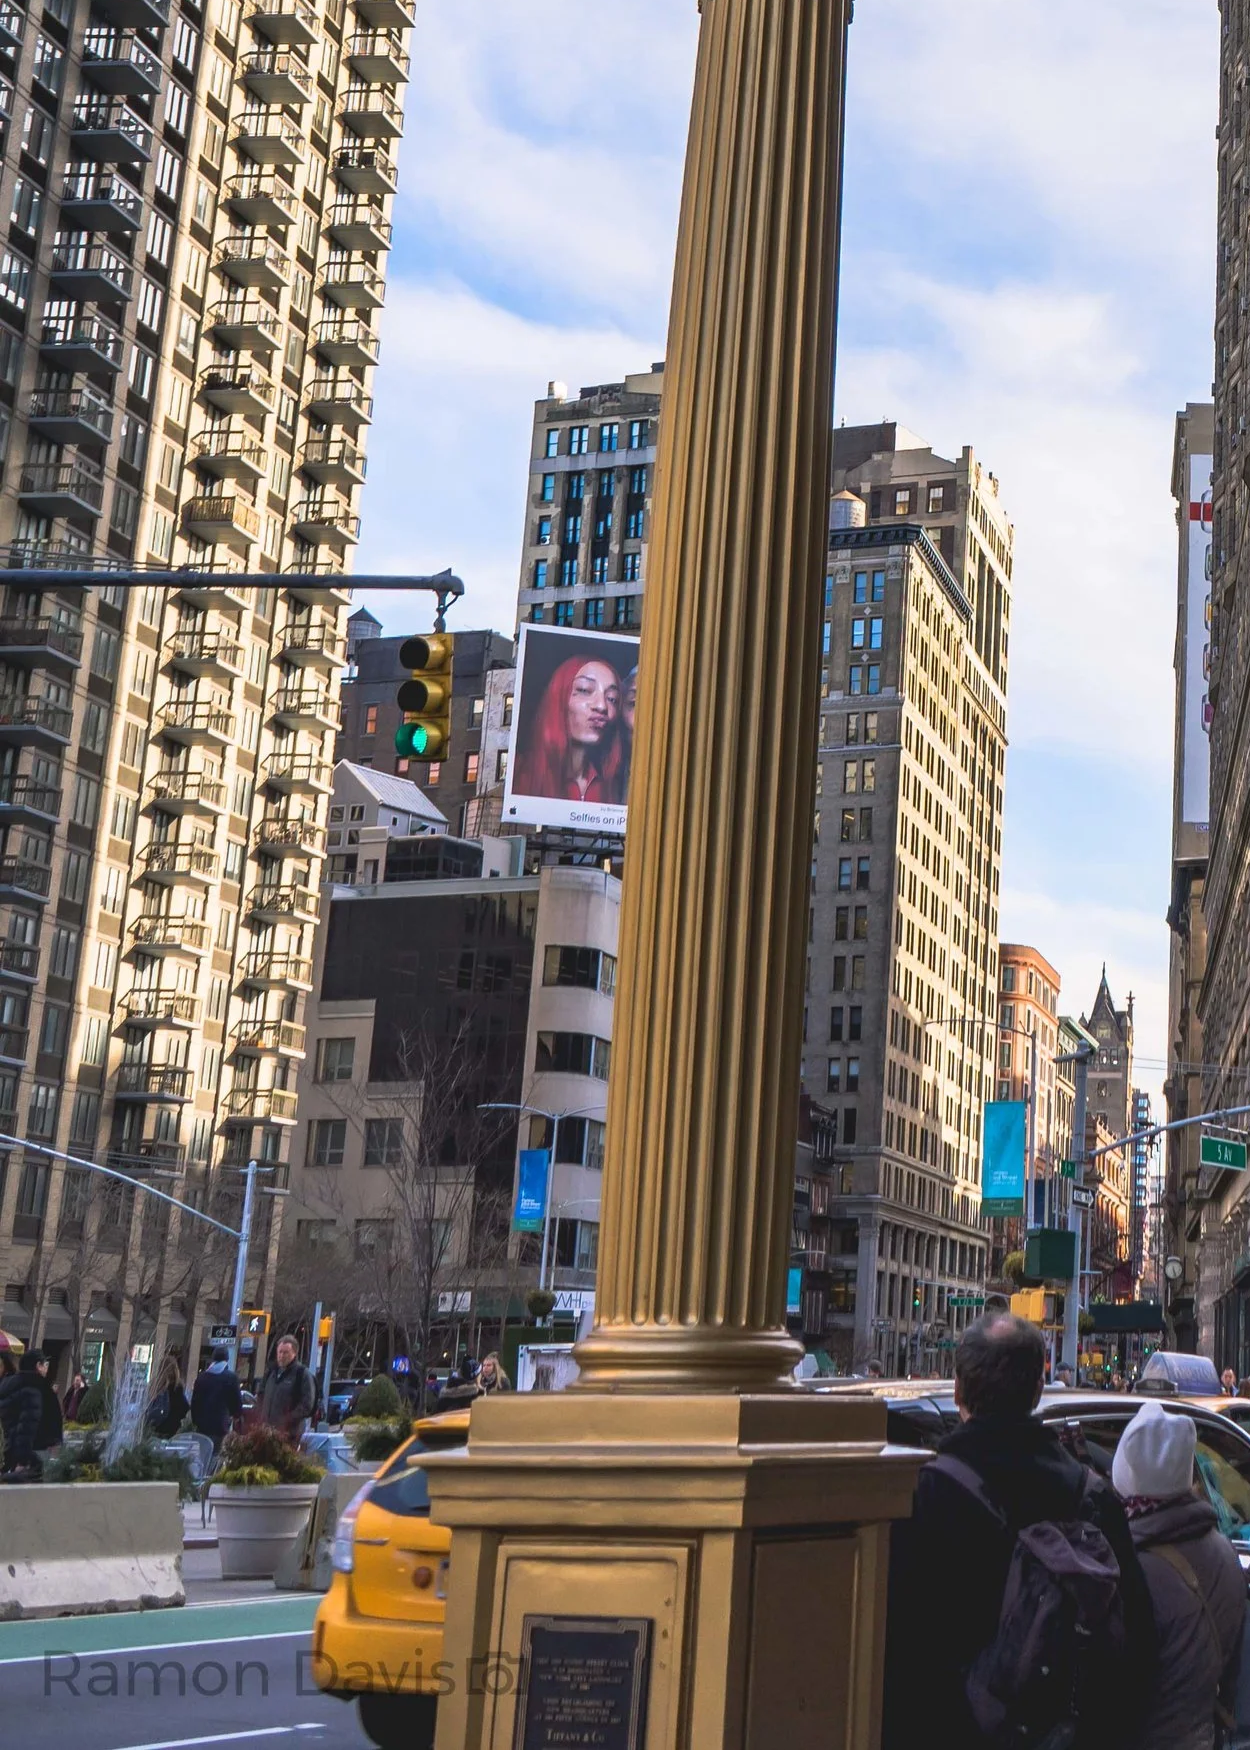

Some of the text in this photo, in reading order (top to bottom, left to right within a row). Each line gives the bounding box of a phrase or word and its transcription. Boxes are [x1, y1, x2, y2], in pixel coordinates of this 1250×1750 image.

[570, 812, 600, 824] Selfies
[603, 817, 615, 825] on
[1218, 1144, 1222, 1161] 5
